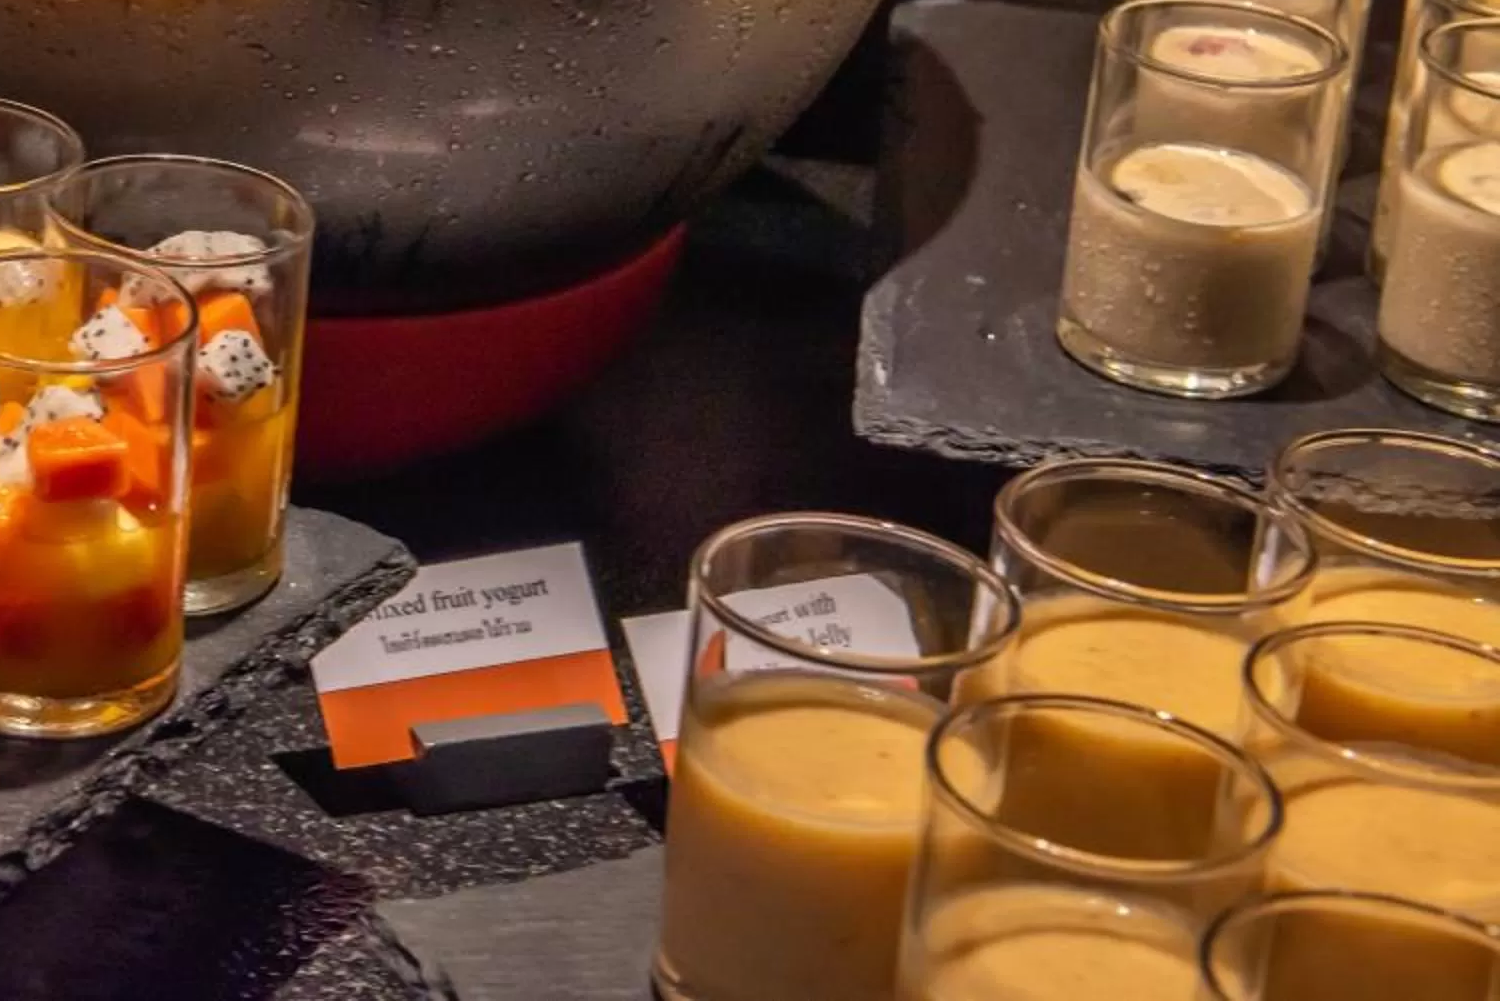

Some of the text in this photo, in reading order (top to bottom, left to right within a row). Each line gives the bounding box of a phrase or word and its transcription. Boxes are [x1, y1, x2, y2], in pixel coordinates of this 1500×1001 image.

[432, 587, 477, 611] fruit
[481, 579, 548, 609] yogurt
[793, 591, 836, 618] with
[807, 623, 852, 648] Jelly
